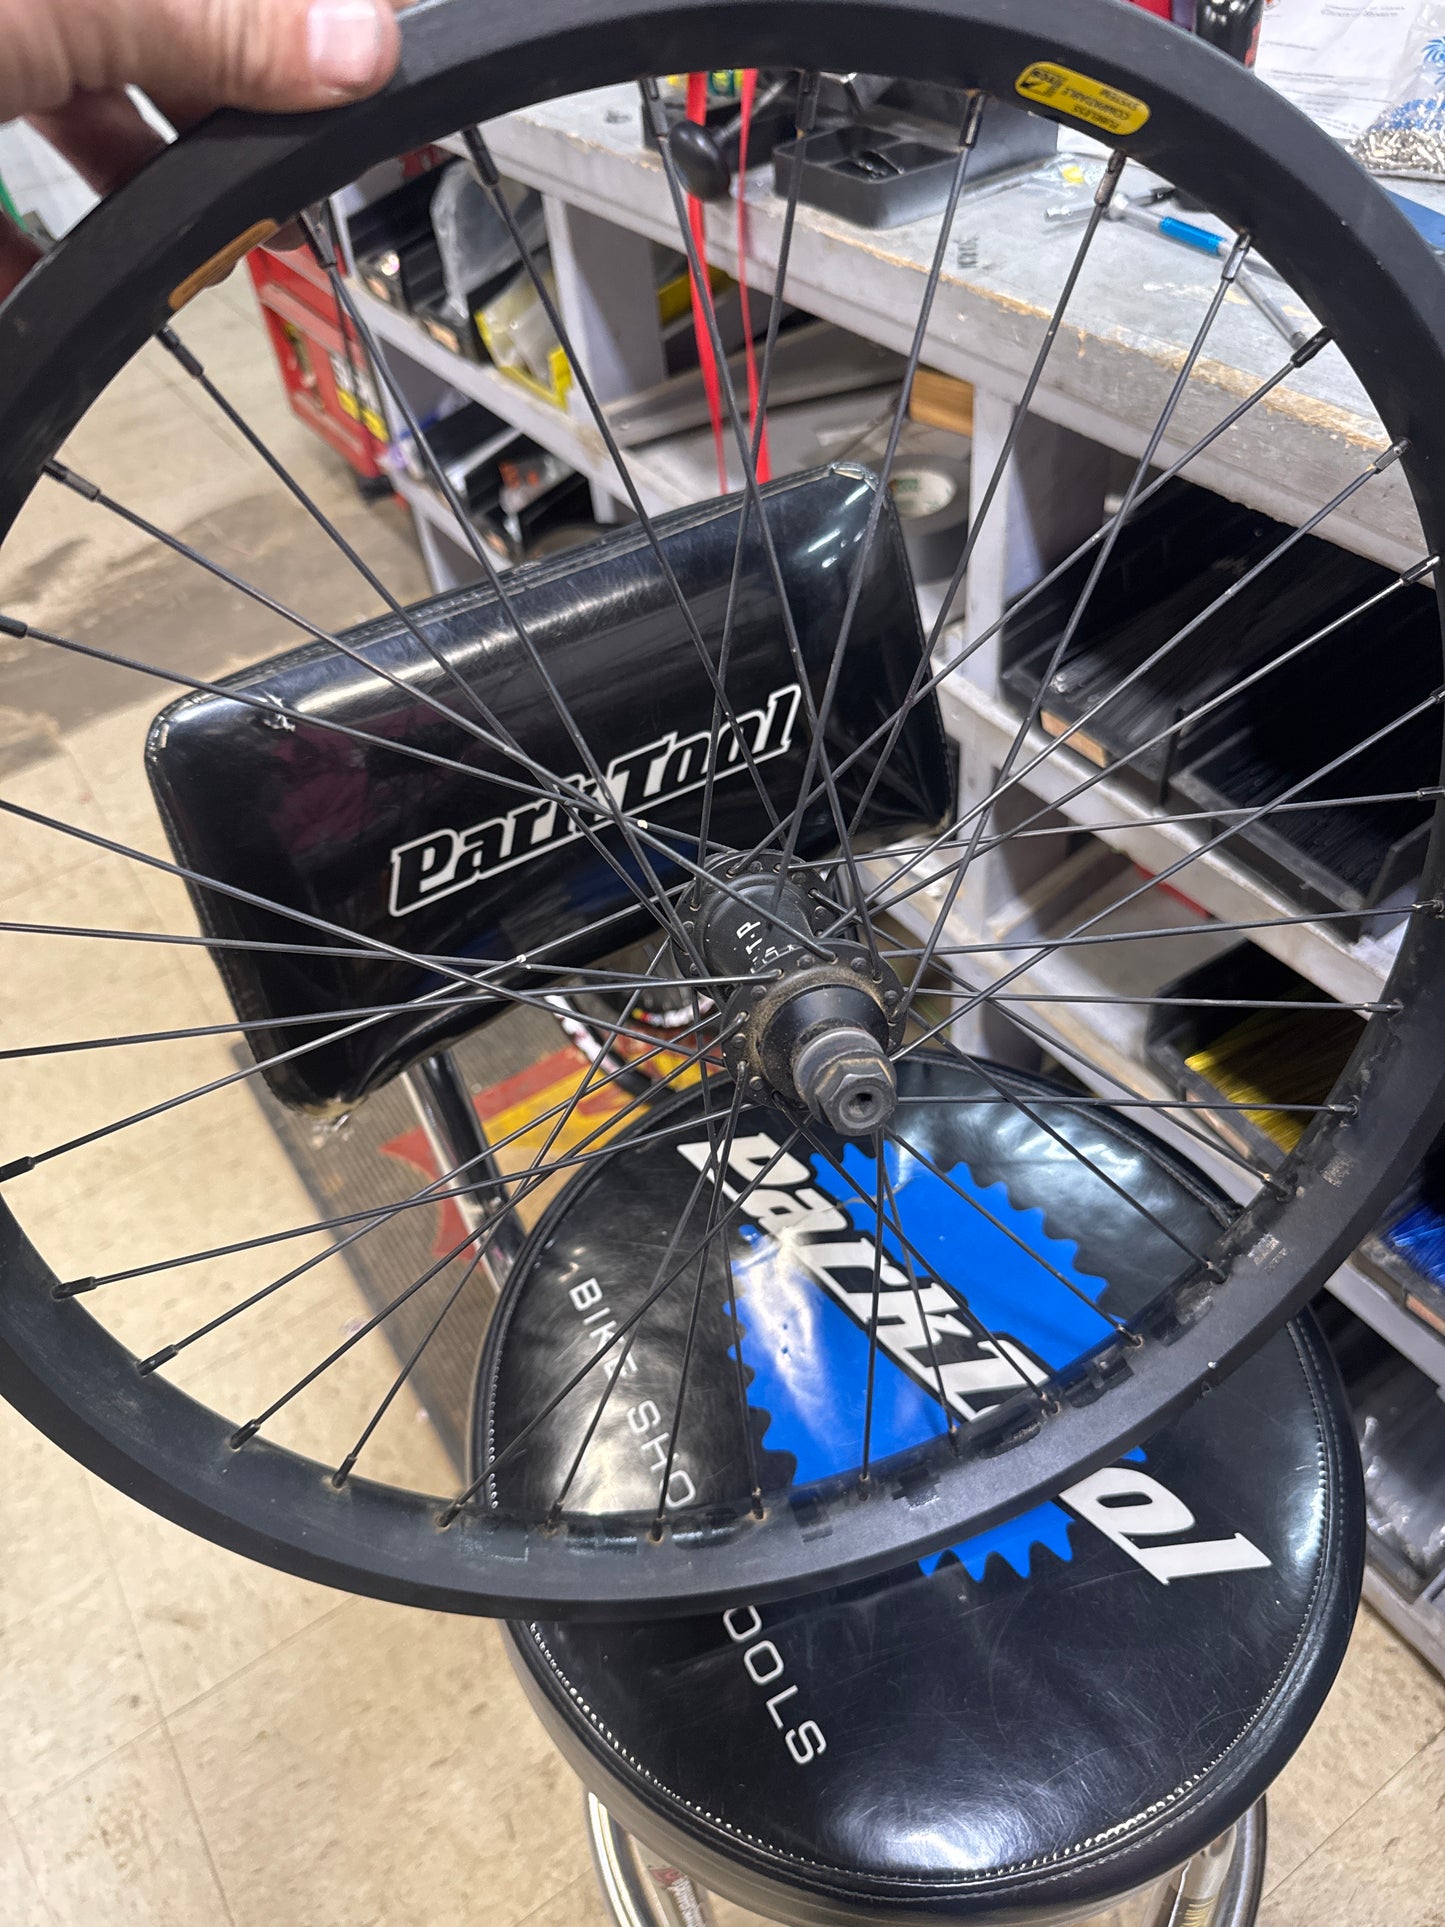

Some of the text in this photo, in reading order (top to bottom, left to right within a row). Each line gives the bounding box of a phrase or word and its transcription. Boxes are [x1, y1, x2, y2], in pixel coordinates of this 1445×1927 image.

[569, 1278, 827, 1765] BIKE SHO OOLS
